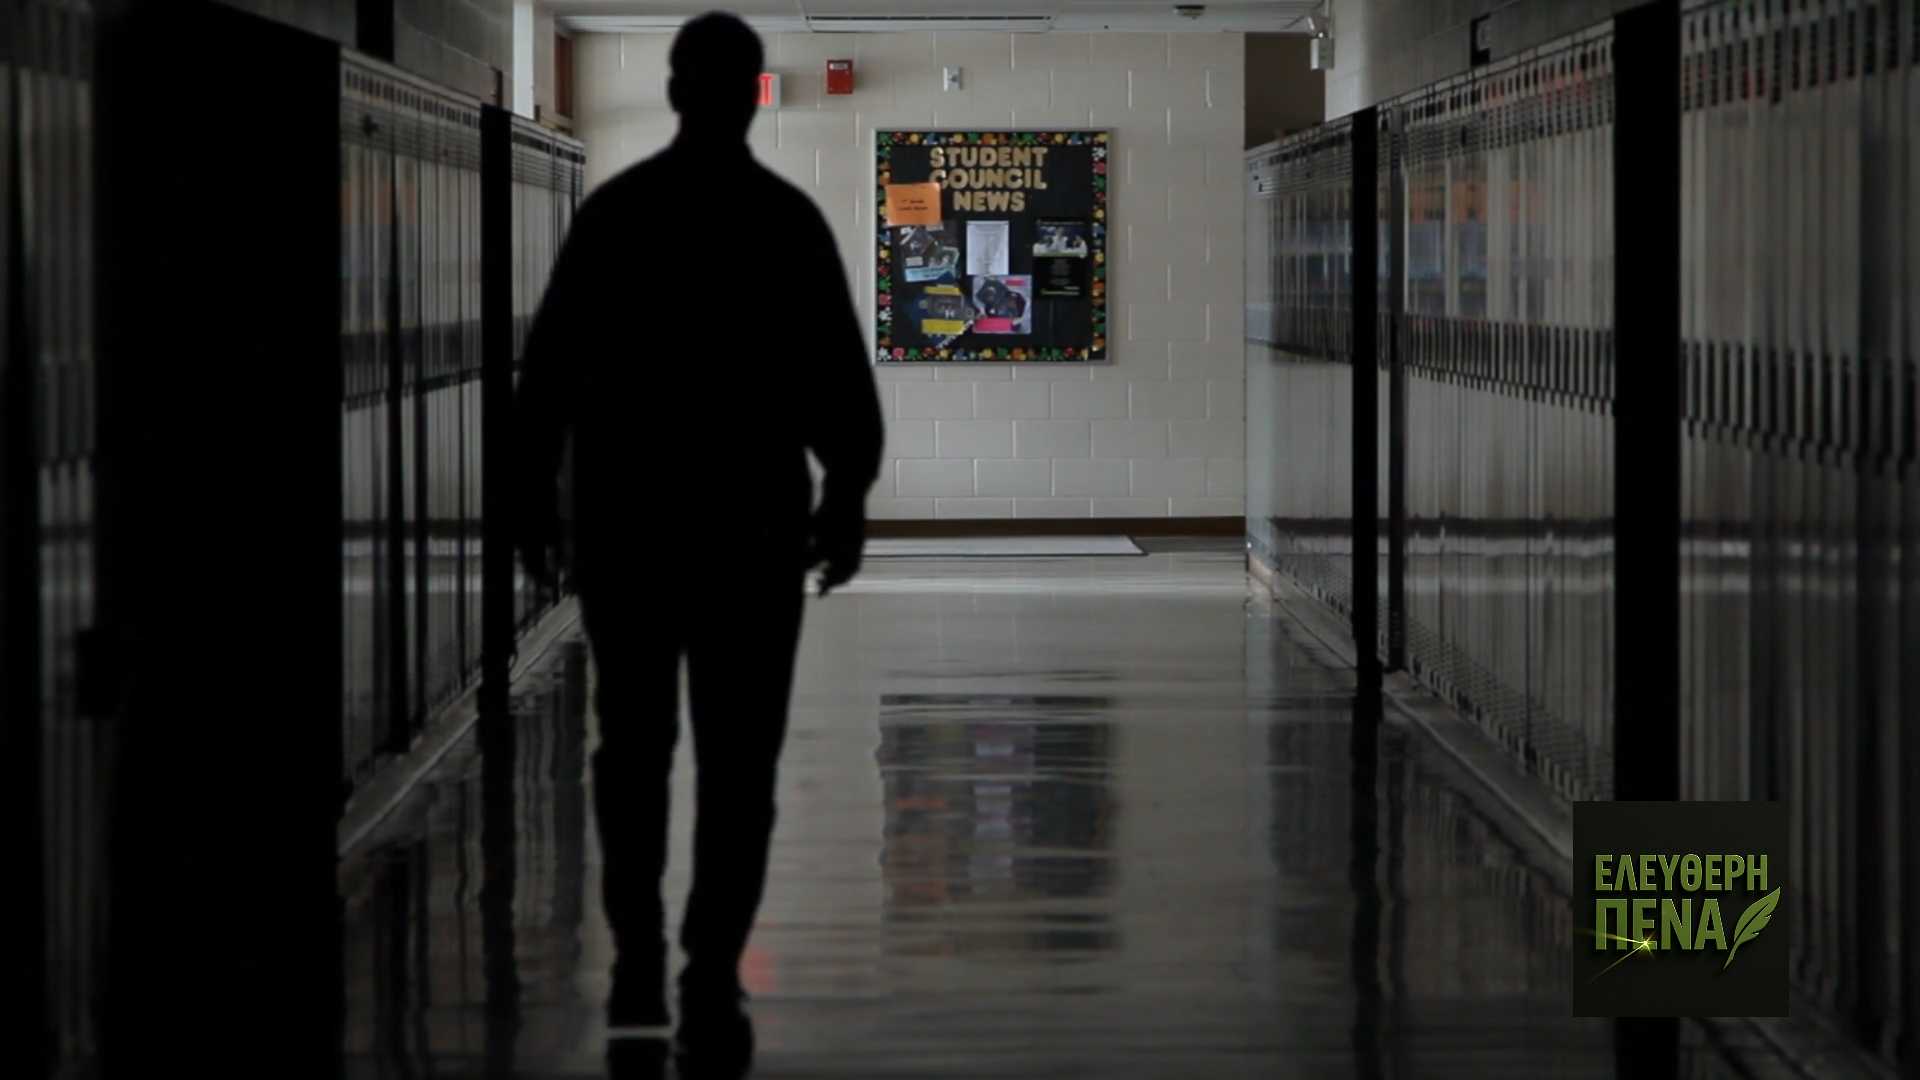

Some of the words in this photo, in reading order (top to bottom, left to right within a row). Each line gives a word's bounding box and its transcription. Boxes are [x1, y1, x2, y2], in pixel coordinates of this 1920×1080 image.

[929, 147, 1048, 168] STUDENT
[929, 168, 1048, 190] COUNCIL
[953, 191, 1026, 212] NEWS
